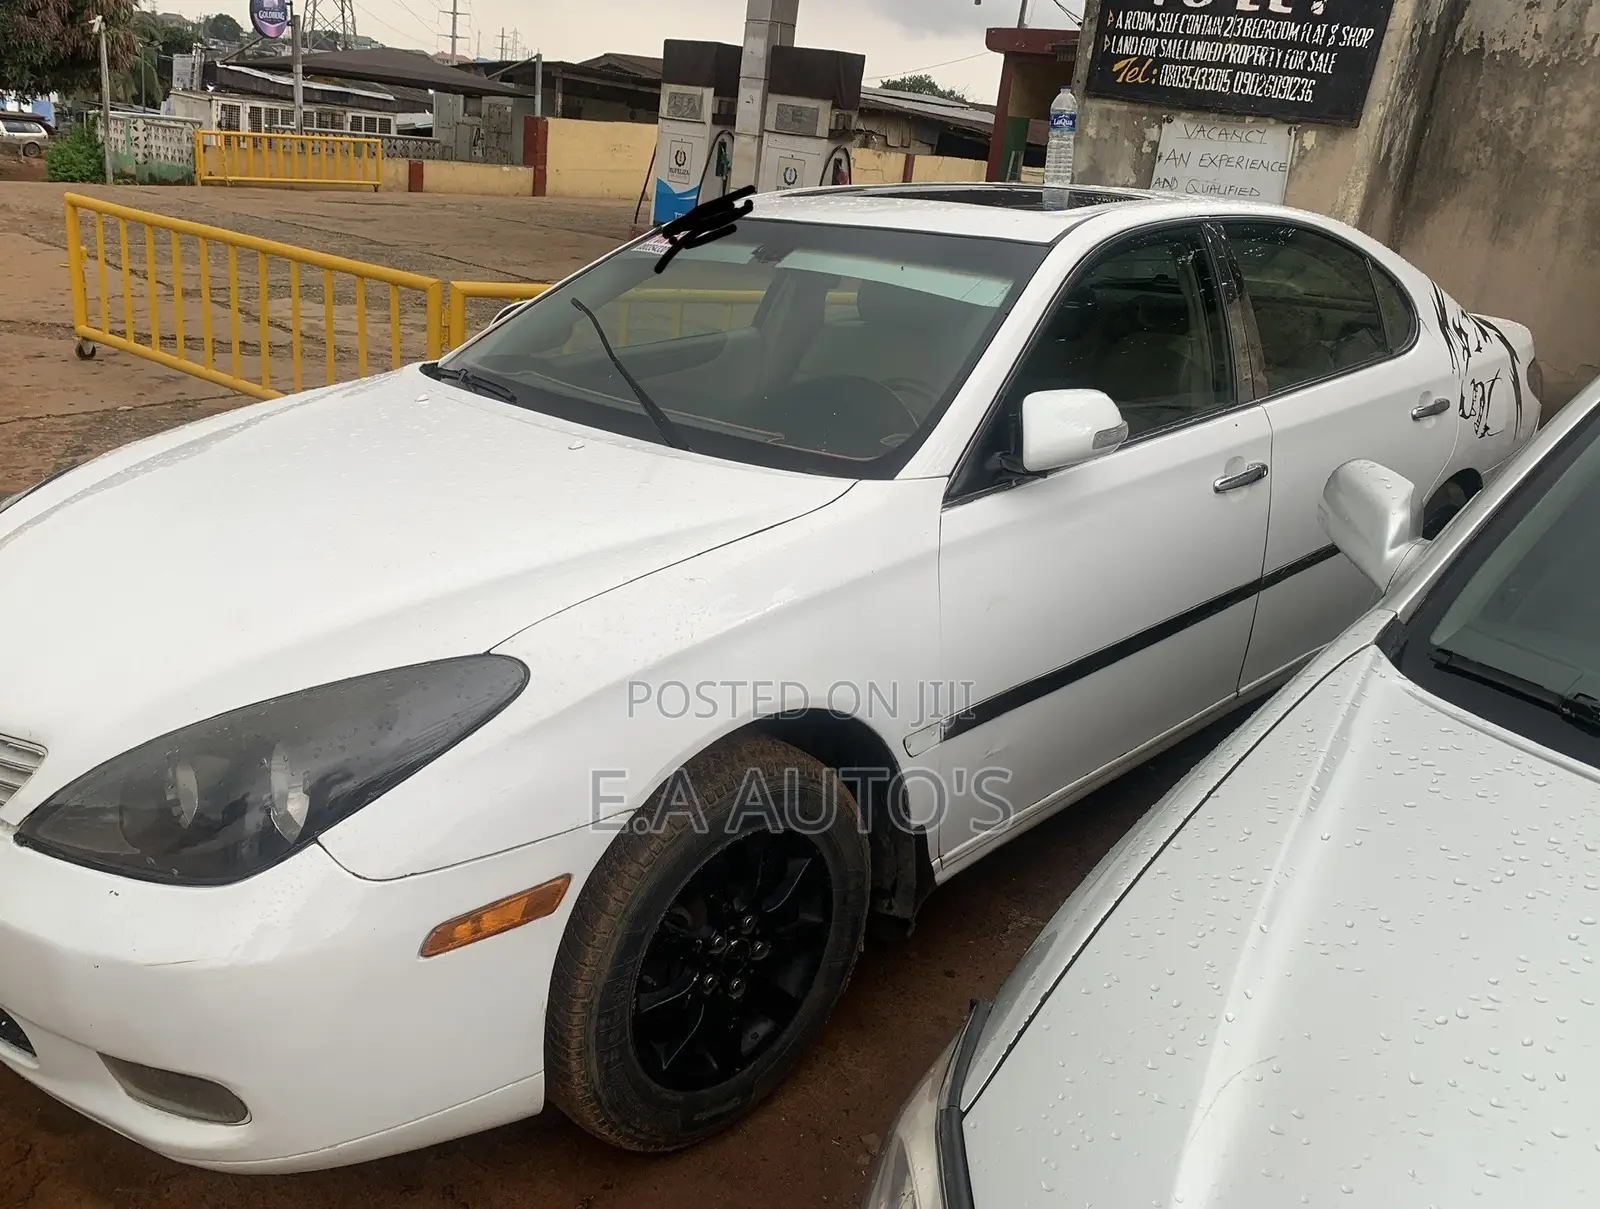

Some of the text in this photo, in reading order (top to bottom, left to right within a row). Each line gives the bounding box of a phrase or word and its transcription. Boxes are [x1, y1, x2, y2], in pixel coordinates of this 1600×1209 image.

[259, 10, 284, 20] GOLDBERG
[1115, 10, 1123, 30] A
[1124, 11, 1157, 32] ROOM
[1156, 12, 1180, 34] SELF
[1242, 17, 1300, 41] BEDROOM
[1300, 22, 1328, 46] FLAT
[1111, 35, 1138, 55] LAND
[1138, 37, 1158, 57] FOR
[1221, 43, 1283, 68] PROPERTY
[1283, 49, 1307, 70] FOR
[1307, 51, 1337, 73] SALE
[1184, 124, 1266, 143] VACANCY
[1198, 153, 1287, 172] EXPERIENCE
[1152, 176, 1260, 196] AND QUALIFIED
